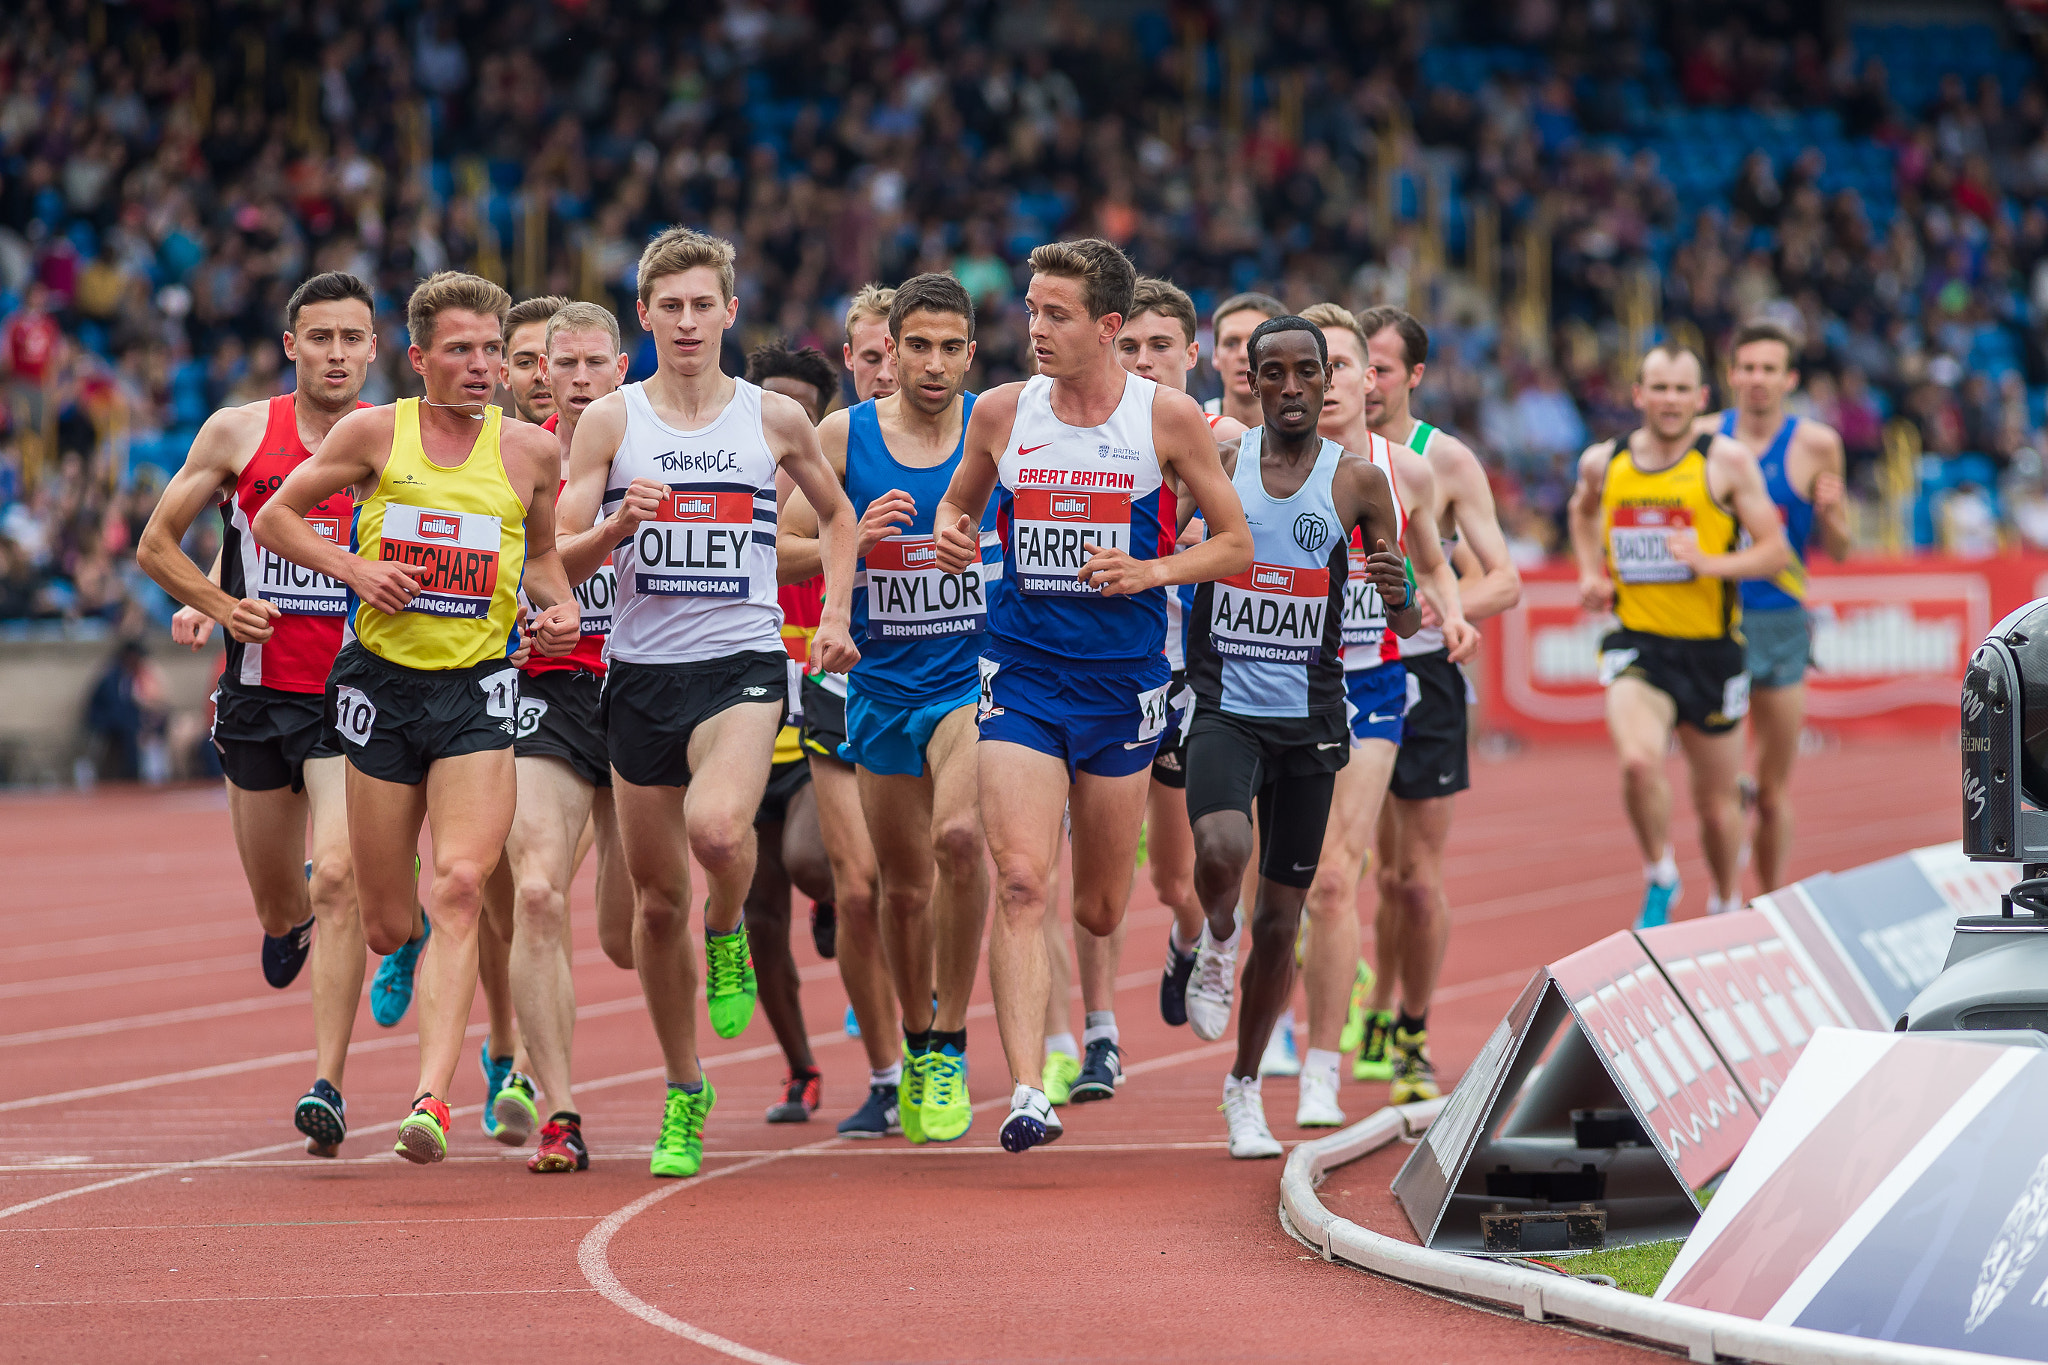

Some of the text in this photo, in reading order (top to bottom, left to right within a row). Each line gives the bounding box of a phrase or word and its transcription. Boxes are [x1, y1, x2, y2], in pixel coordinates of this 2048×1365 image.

[1113, 447, 1140, 456] BRITISH
[653, 449, 737, 474] TONBRIDGE
[1018, 468, 1134, 490] GREAT BRITAIN
[679, 499, 712, 514] müller
[1054, 498, 1086, 512] müller
[422, 518, 457, 536] müller
[639, 528, 750, 569] OLLEY
[647, 578, 740, 593] BIRMINGHAM
[1256, 571, 1290, 586] müller
[872, 570, 983, 614] TAYLOR
[1214, 591, 1322, 639] AADAN
[882, 618, 976, 636] BIRMINGHAM
[1217, 640, 1308, 661] BIRMINGHAM
[340, 696, 372, 735] 10
